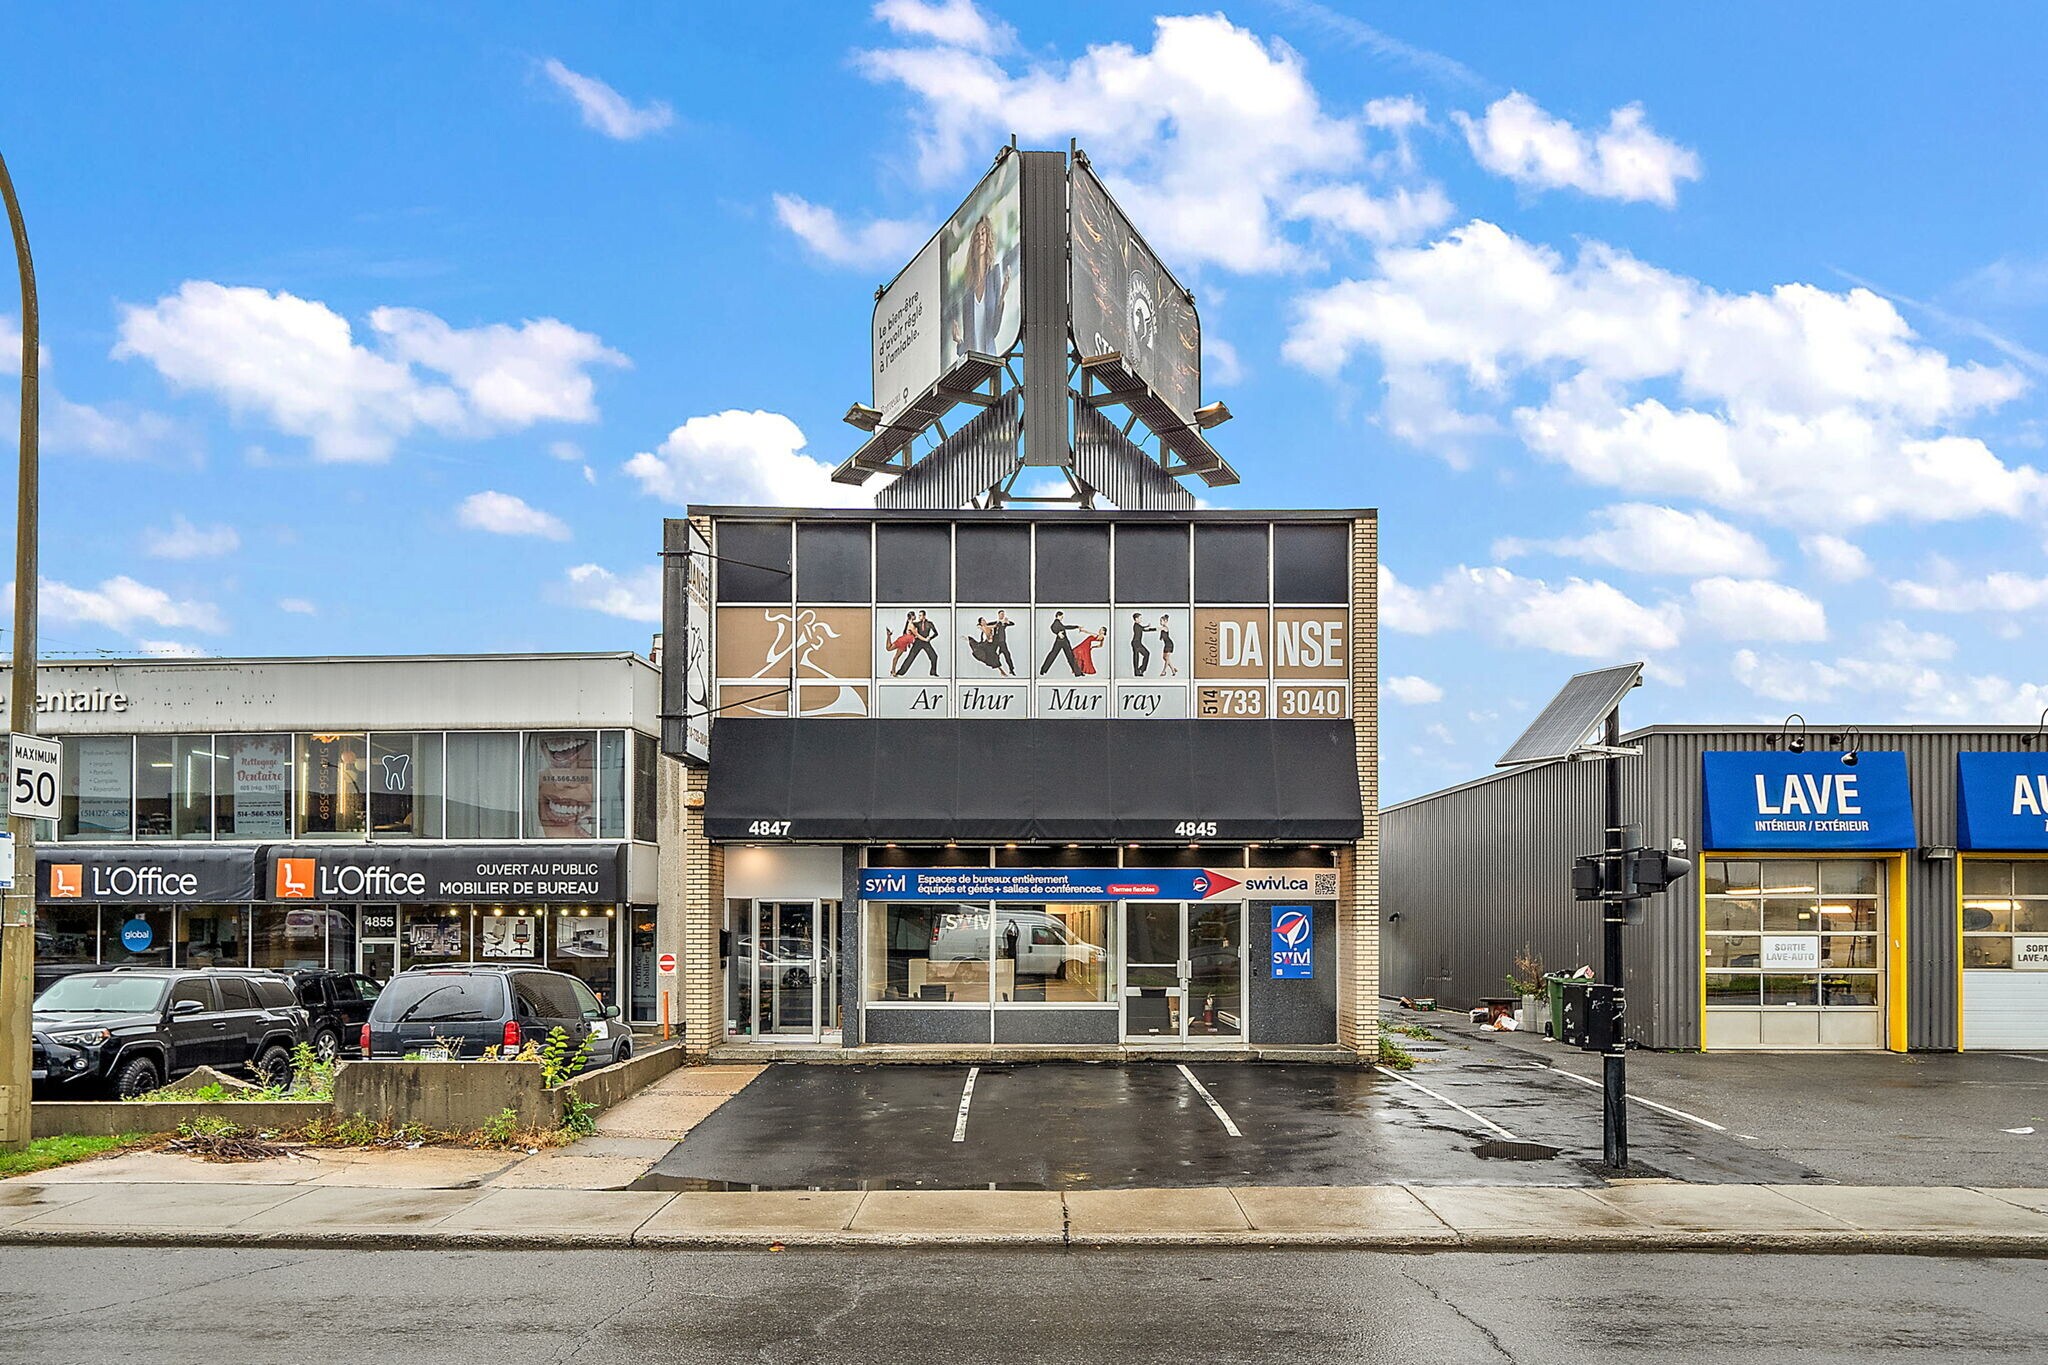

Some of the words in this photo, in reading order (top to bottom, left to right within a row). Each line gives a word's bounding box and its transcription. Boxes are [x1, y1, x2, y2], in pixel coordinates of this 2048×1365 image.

[879, 325, 887, 339] Le
[887, 291, 919, 330] bien-être
[879, 323, 904, 356] d'avoir
[904, 302, 923, 332] réglé
[879, 360, 885, 373] à
[1204, 621, 1218, 635] de
[1219, 620, 1264, 667] DA
[1276, 620, 1343, 667] NSE
[1202, 636, 1218, 667] École
[36, 687, 128, 713] entaire
[1203, 690, 1218, 714] 514
[1220, 690, 1261, 715] 733
[1282, 690, 1340, 715] 3040
[15, 745, 57, 765] MAXIMUM
[241, 757, 277, 770] Nettoyage
[237, 769, 282, 782] Dentaire
[15, 767, 55, 807] 50
[1755, 774, 1862, 815] LAVE
[749, 821, 792, 836] 4847
[1175, 822, 1217, 837] 4845
[1755, 819, 1806, 832] INTÉRIEUR
[1815, 819, 1869, 832] EXTÉRIEUR
[476, 864, 529, 876] OUVERT
[530, 864, 549, 876] AU
[552, 864, 598, 876] PUBLIC
[93, 866, 197, 896] L'Office
[320, 865, 425, 895] L'Office
[865, 874, 906, 893] swivl
[918, 874, 957, 885] Espaces
[958, 874, 971, 884] de
[972, 874, 1011, 884] bureaux
[1012, 874, 1069, 884] entièrement
[1245, 876, 1308, 890] swivl.ca
[440, 882, 509, 895] MOBILIER
[513, 882, 534, 895] DE
[538, 882, 598, 895] BUREAU
[918, 884, 955, 895] équipés
[956, 885, 966, 893] et
[967, 884, 994, 895] gérés
[1003, 884, 1030, 893] salles
[1031, 884, 1043, 893] de
[1044, 884, 1104, 893] conférences.
[365, 916, 394, 928] 4855
[125, 930, 149, 940] global
[1774, 943, 1806, 951] SORTIE
[1273, 948, 1311, 965] swivl
[1766, 953, 1815, 961] LAVE-AUTO
